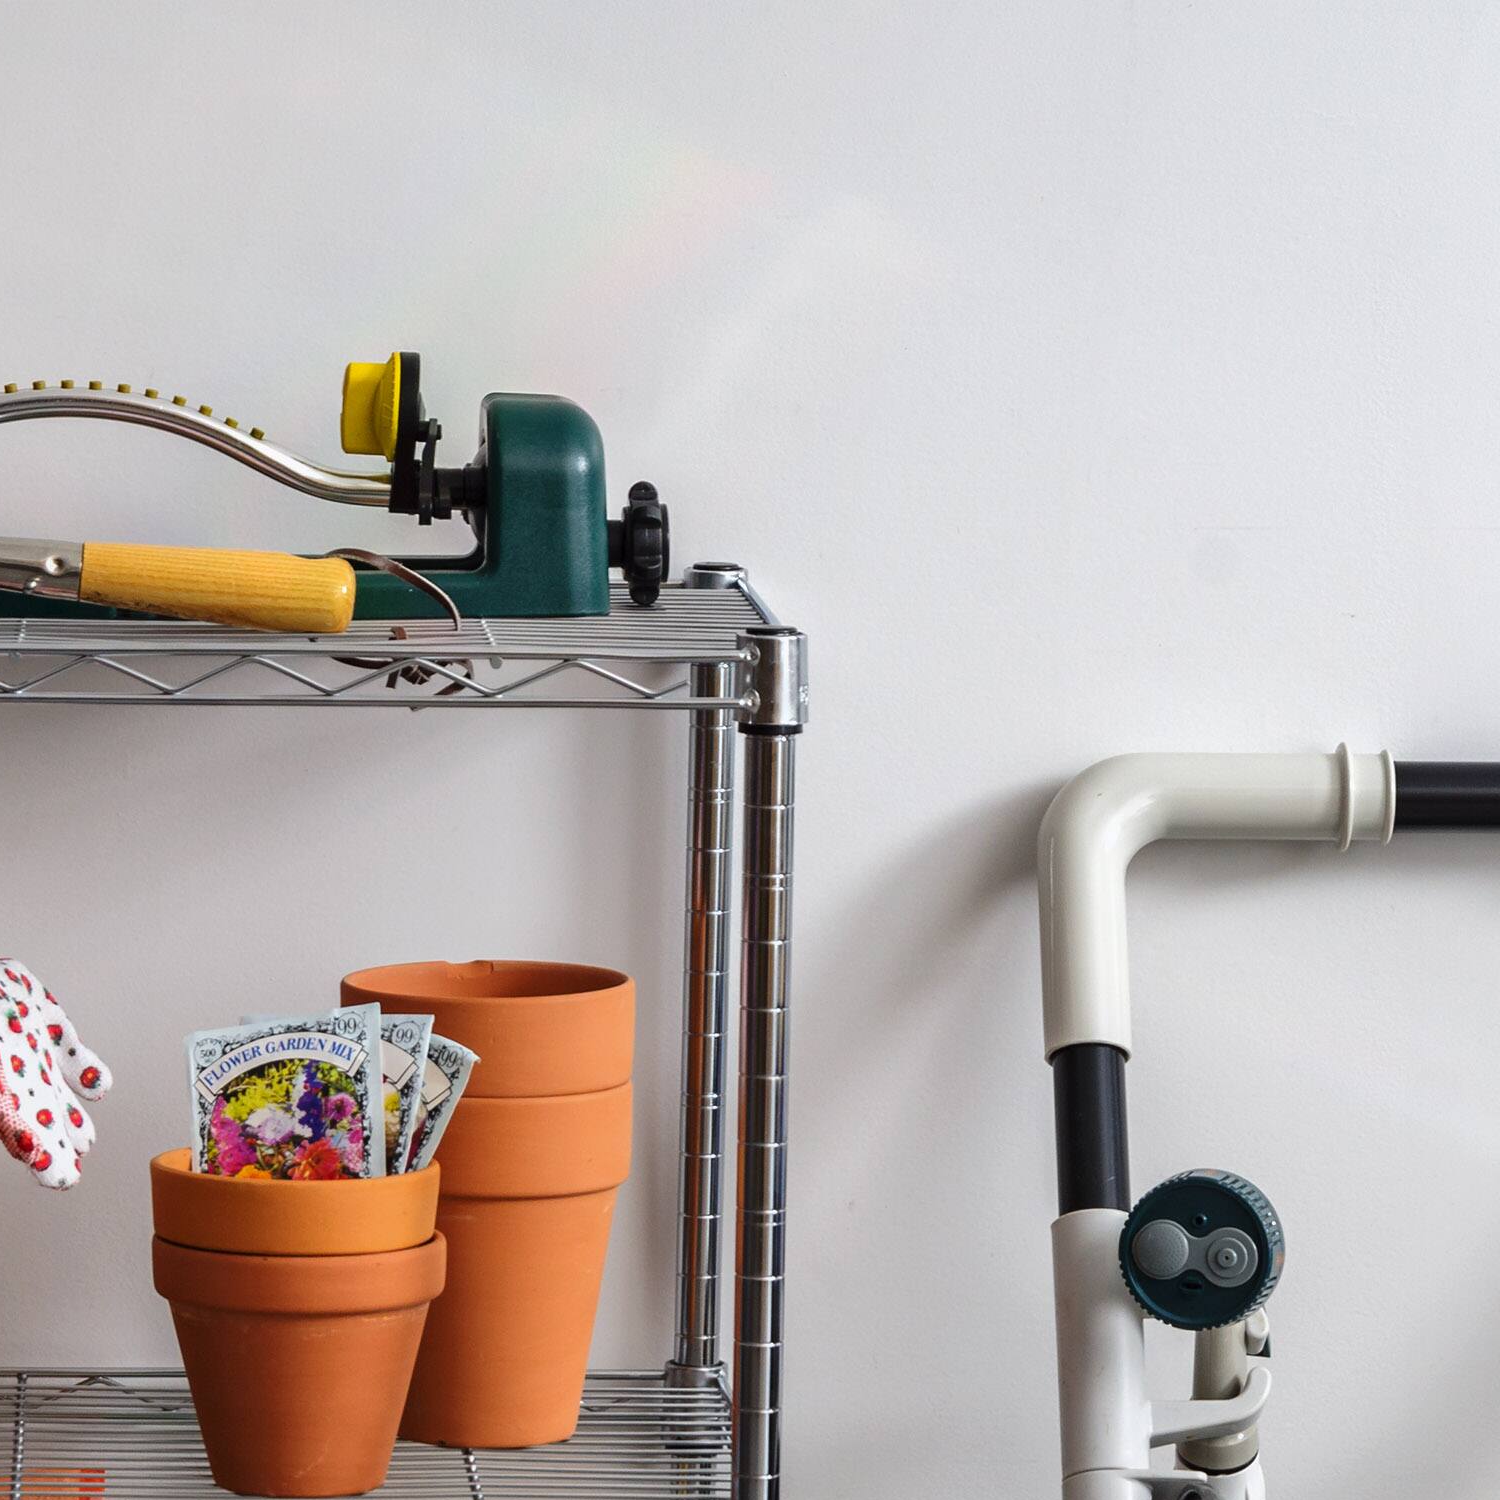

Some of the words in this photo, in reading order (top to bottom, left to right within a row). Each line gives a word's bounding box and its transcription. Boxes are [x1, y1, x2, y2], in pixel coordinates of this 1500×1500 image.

[203, 1045, 262, 1087] FLOWER
[265, 1037, 327, 1054] GARDEN
[328, 1041, 355, 1062] MIX
